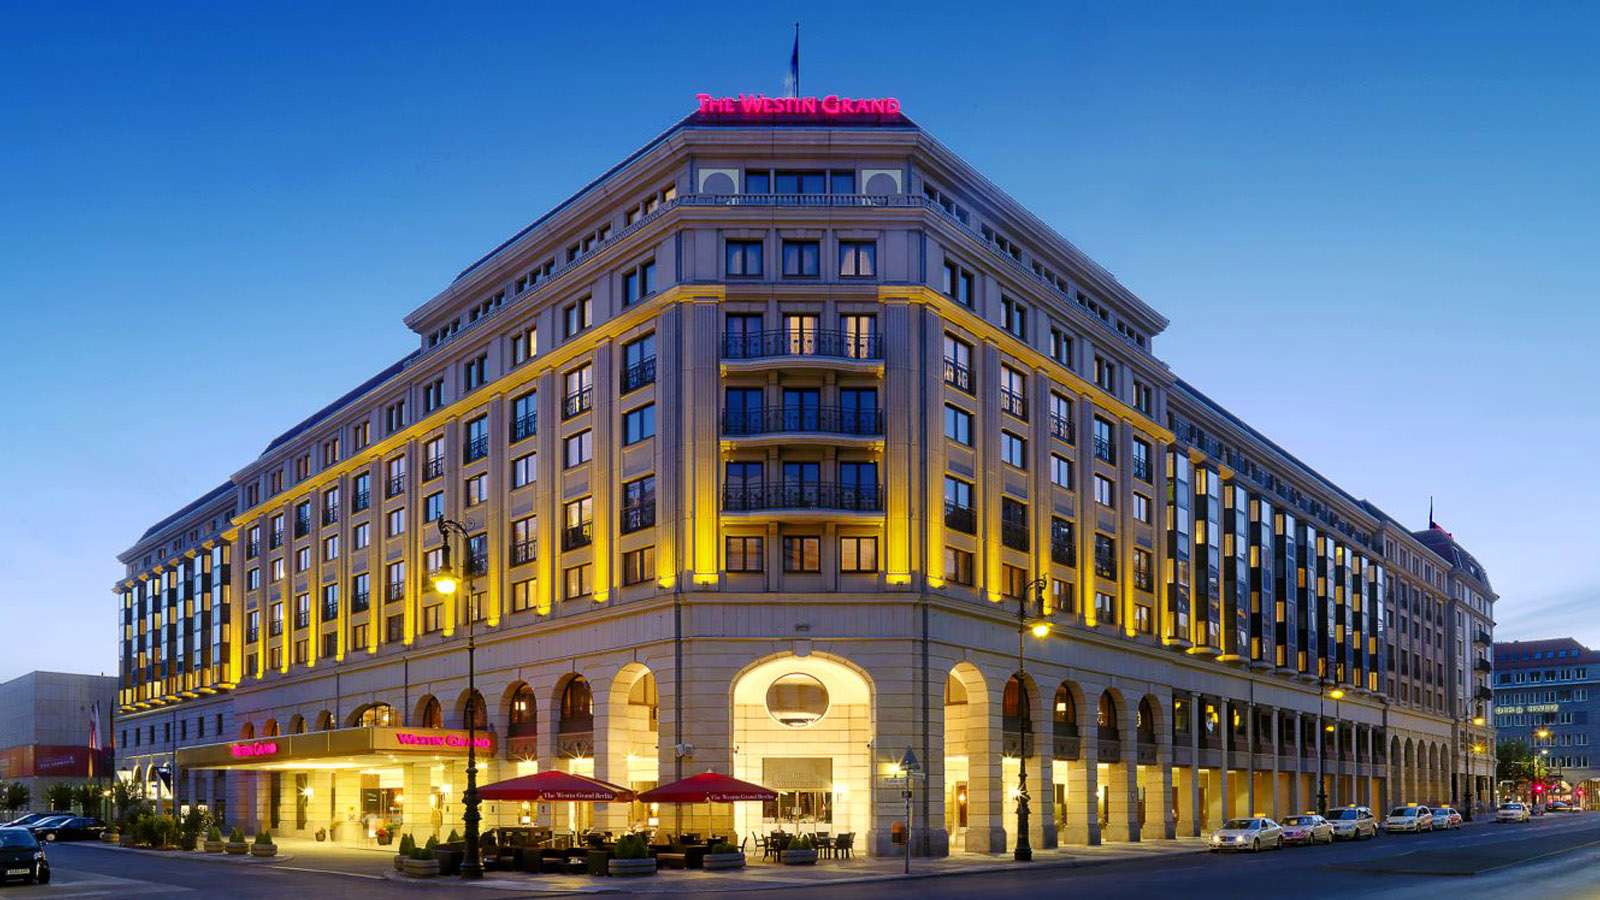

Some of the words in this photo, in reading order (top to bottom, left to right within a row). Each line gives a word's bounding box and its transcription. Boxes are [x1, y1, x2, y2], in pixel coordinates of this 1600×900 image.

[696, 93, 735, 113] THE
[738, 93, 817, 113] WESTIN
[821, 95, 901, 114] GRAND
